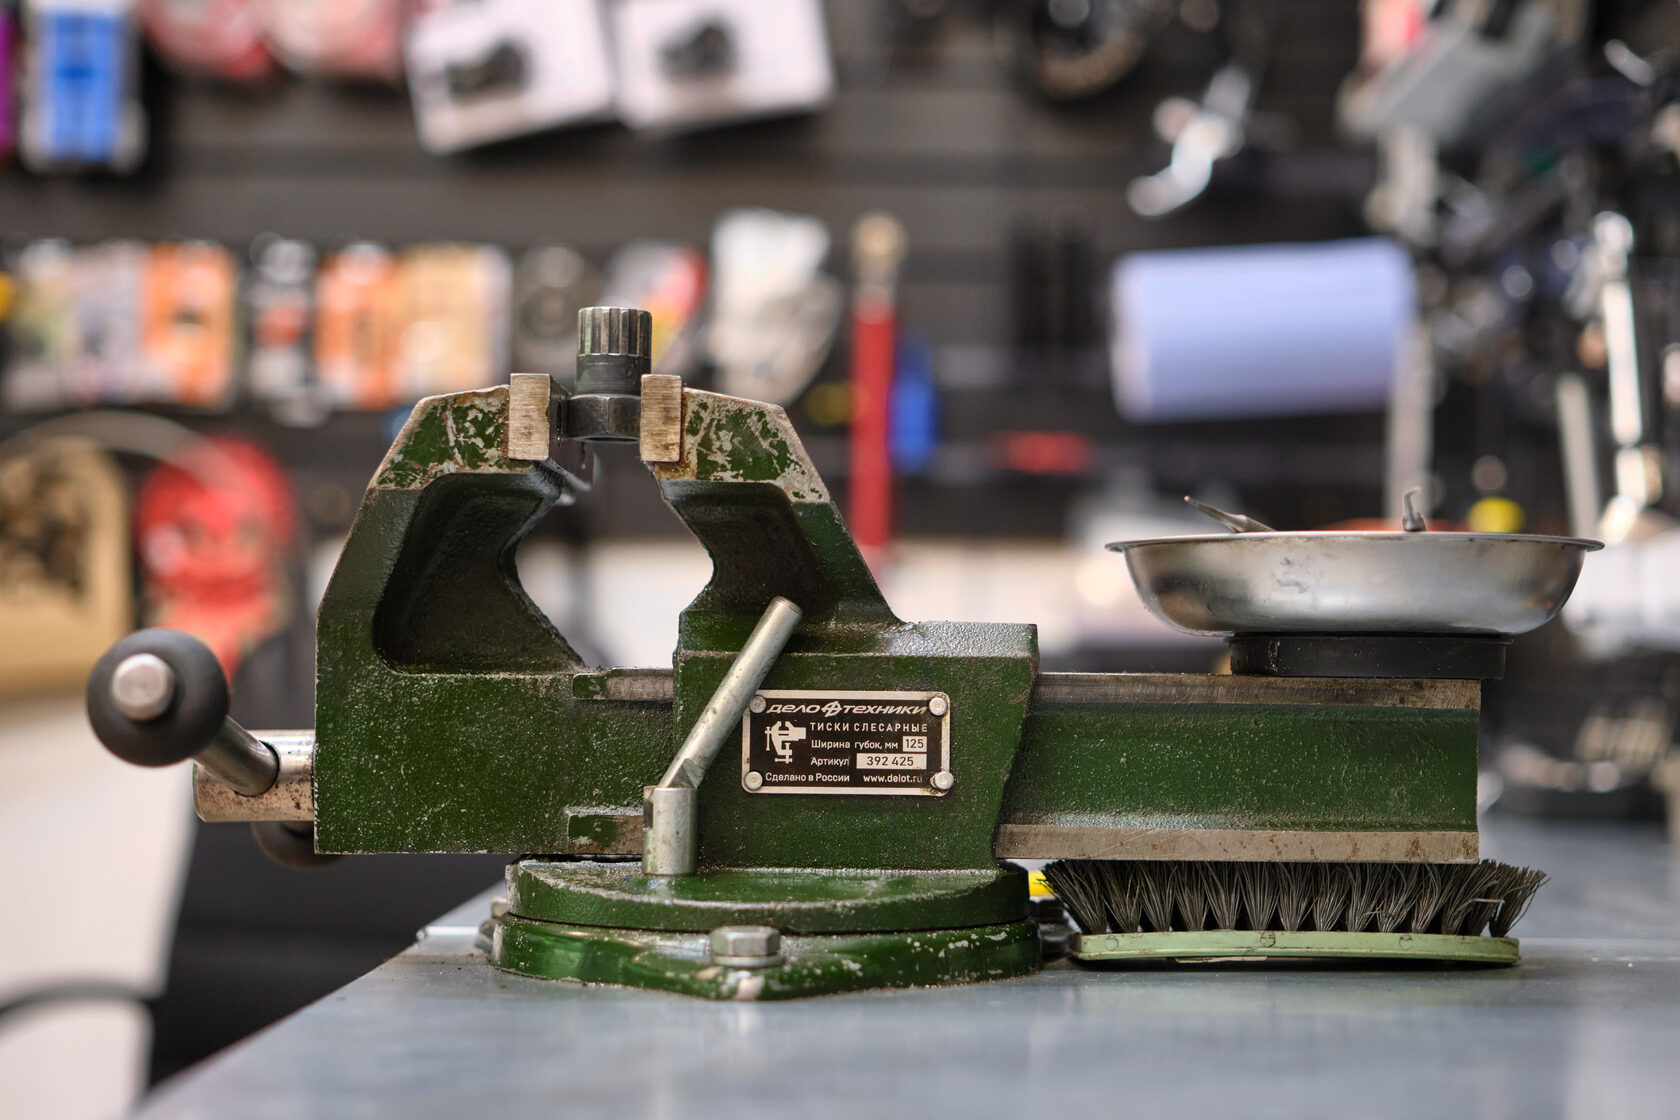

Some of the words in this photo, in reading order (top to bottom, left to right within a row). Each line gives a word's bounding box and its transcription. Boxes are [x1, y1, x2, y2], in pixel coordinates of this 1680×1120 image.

[810, 722, 850, 732] ТИСКИ
[853, 722, 928, 733] СЛЕСАРНЫЕ
[811, 739, 851, 750] Ширина
[854, 740, 882, 751] губок,
[905, 738, 924, 749] 125
[810, 756, 850, 767] Артикул
[866, 756, 889, 766] 392
[891, 756, 914, 766] 425
[765, 772, 807, 782] Сделано
[808, 774, 814, 782] в
[815, 772, 850, 782] России
[863, 773, 923, 783] www.delot.ru
